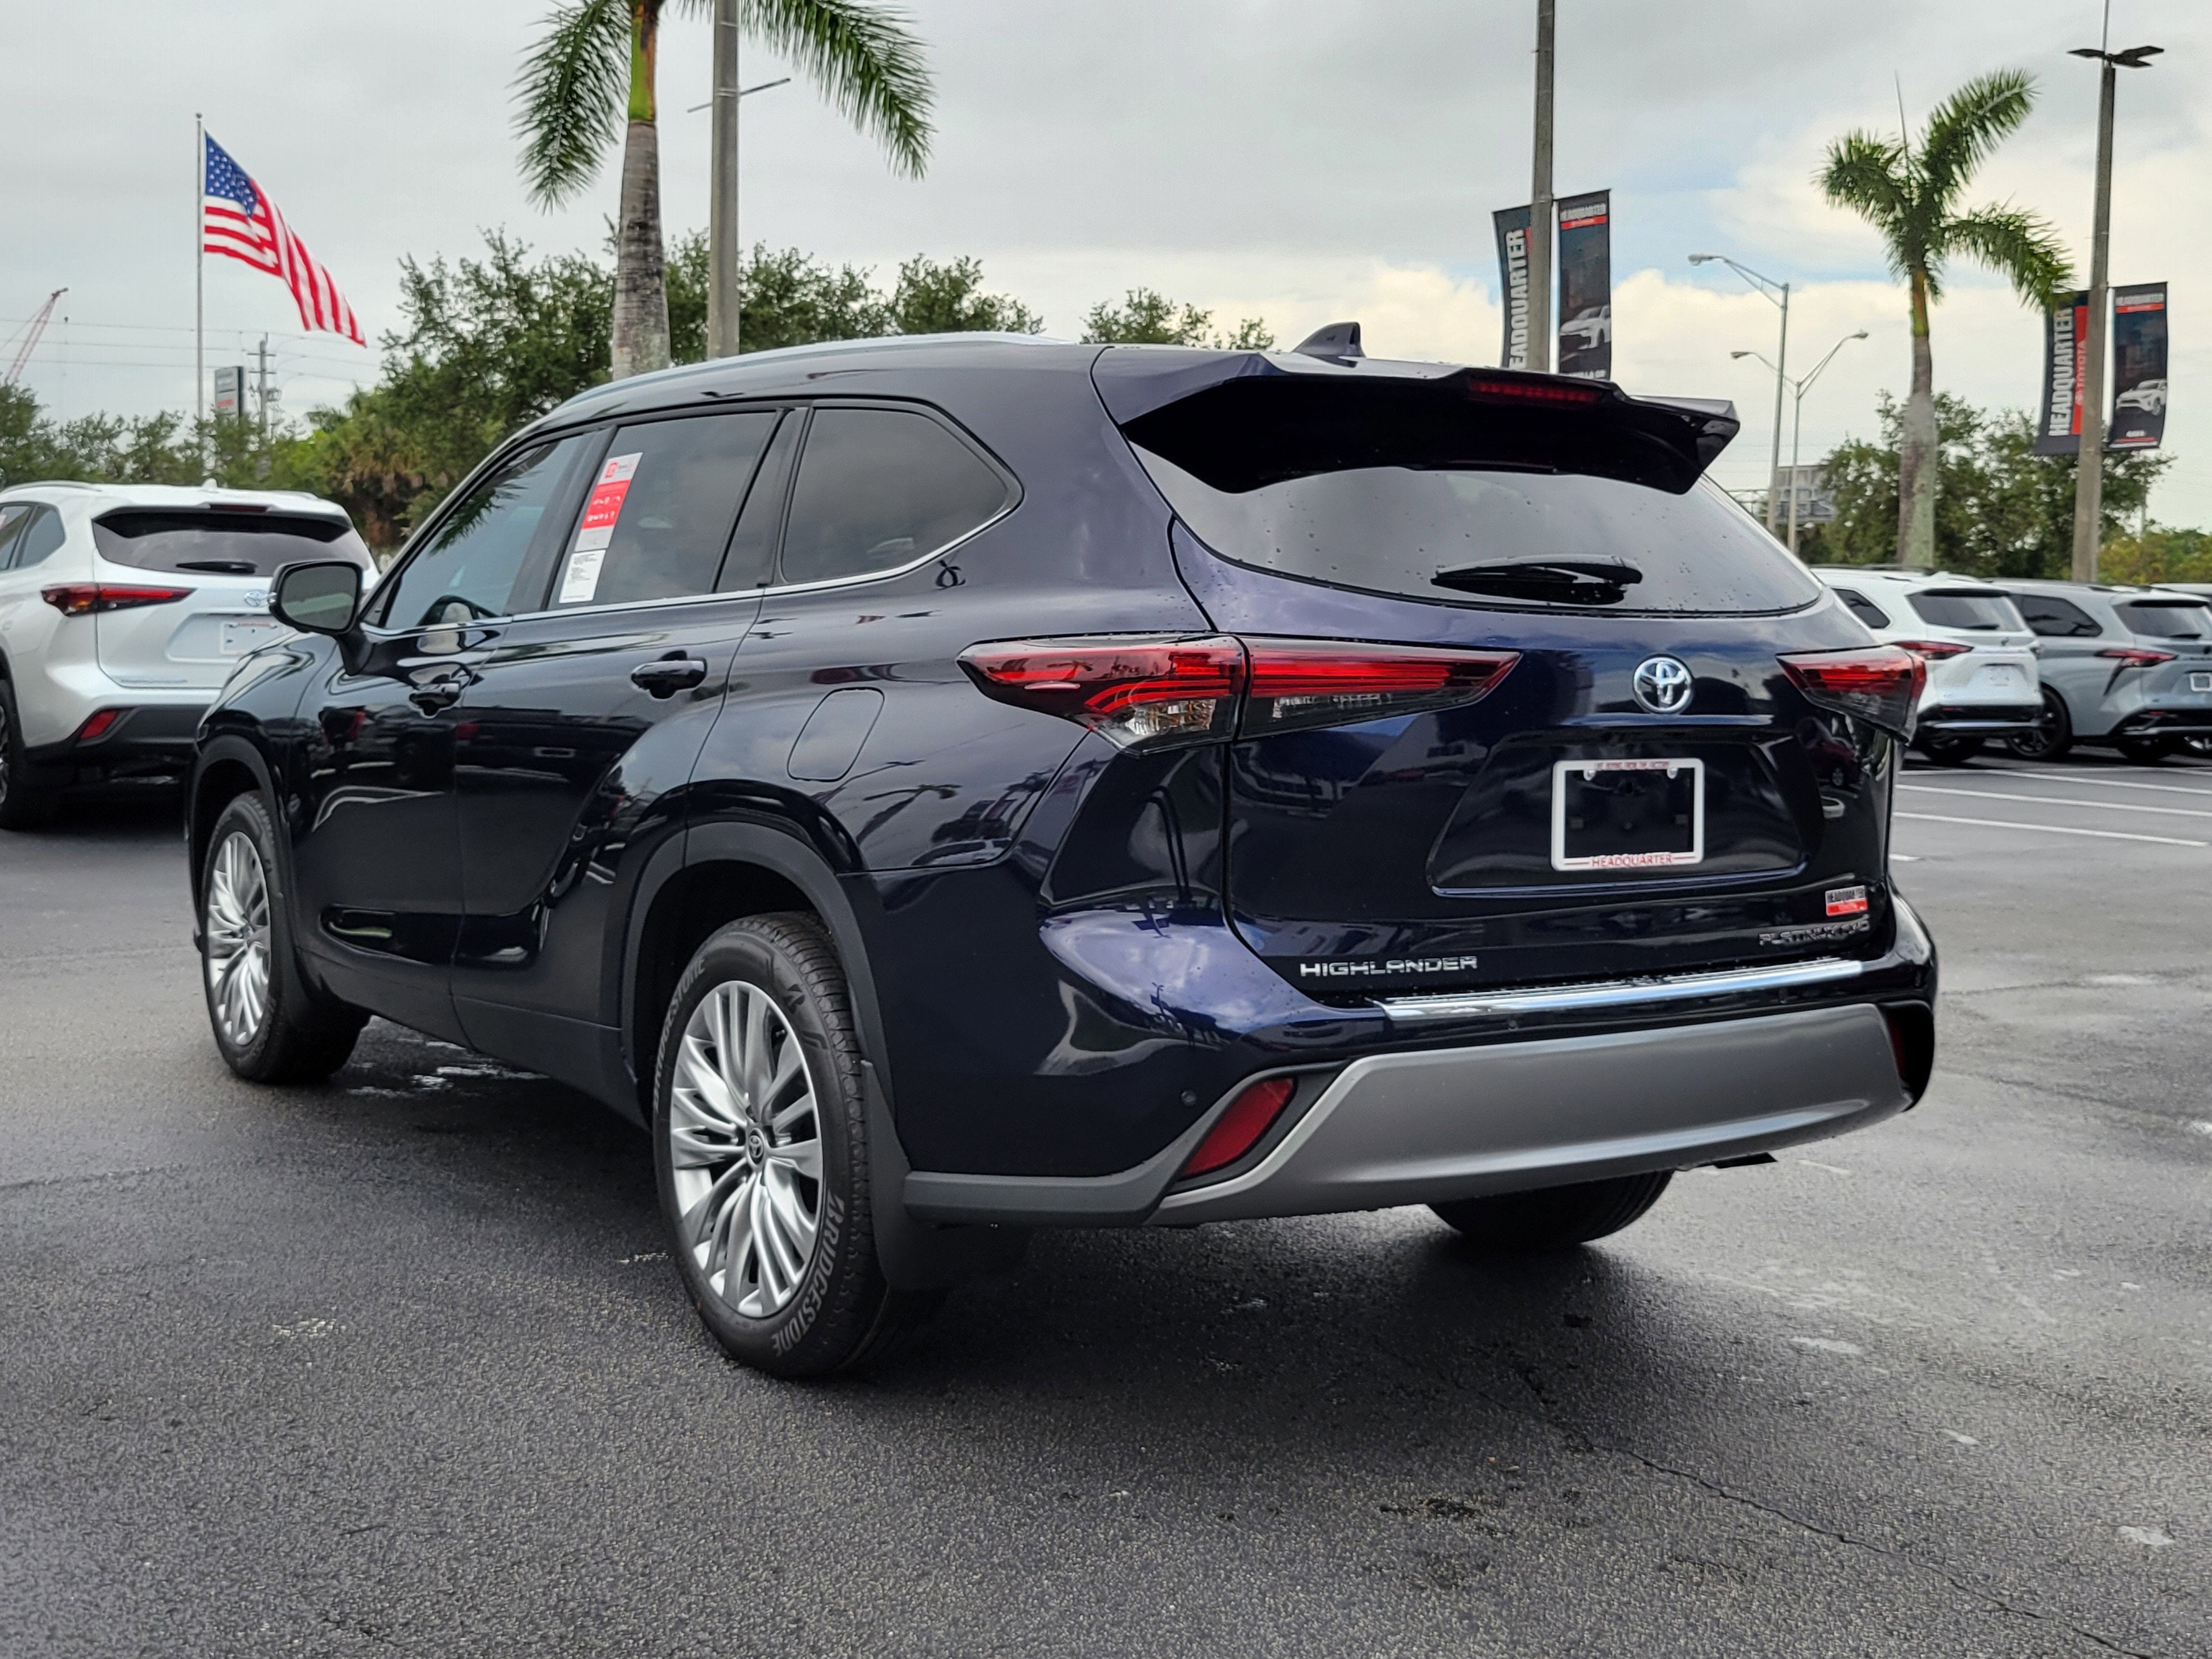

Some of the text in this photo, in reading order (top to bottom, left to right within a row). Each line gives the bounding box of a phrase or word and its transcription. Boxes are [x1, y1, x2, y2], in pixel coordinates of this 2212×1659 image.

[1505, 229, 1528, 370] EADQUARTER
[2048, 308, 2075, 436] HEADQUARTER
[1592, 854, 1673, 868] HEADQUARTER
[1300, 956, 1477, 977] HIGHLANDER
[771, 1188, 845, 1358] BRIDGESTONE
